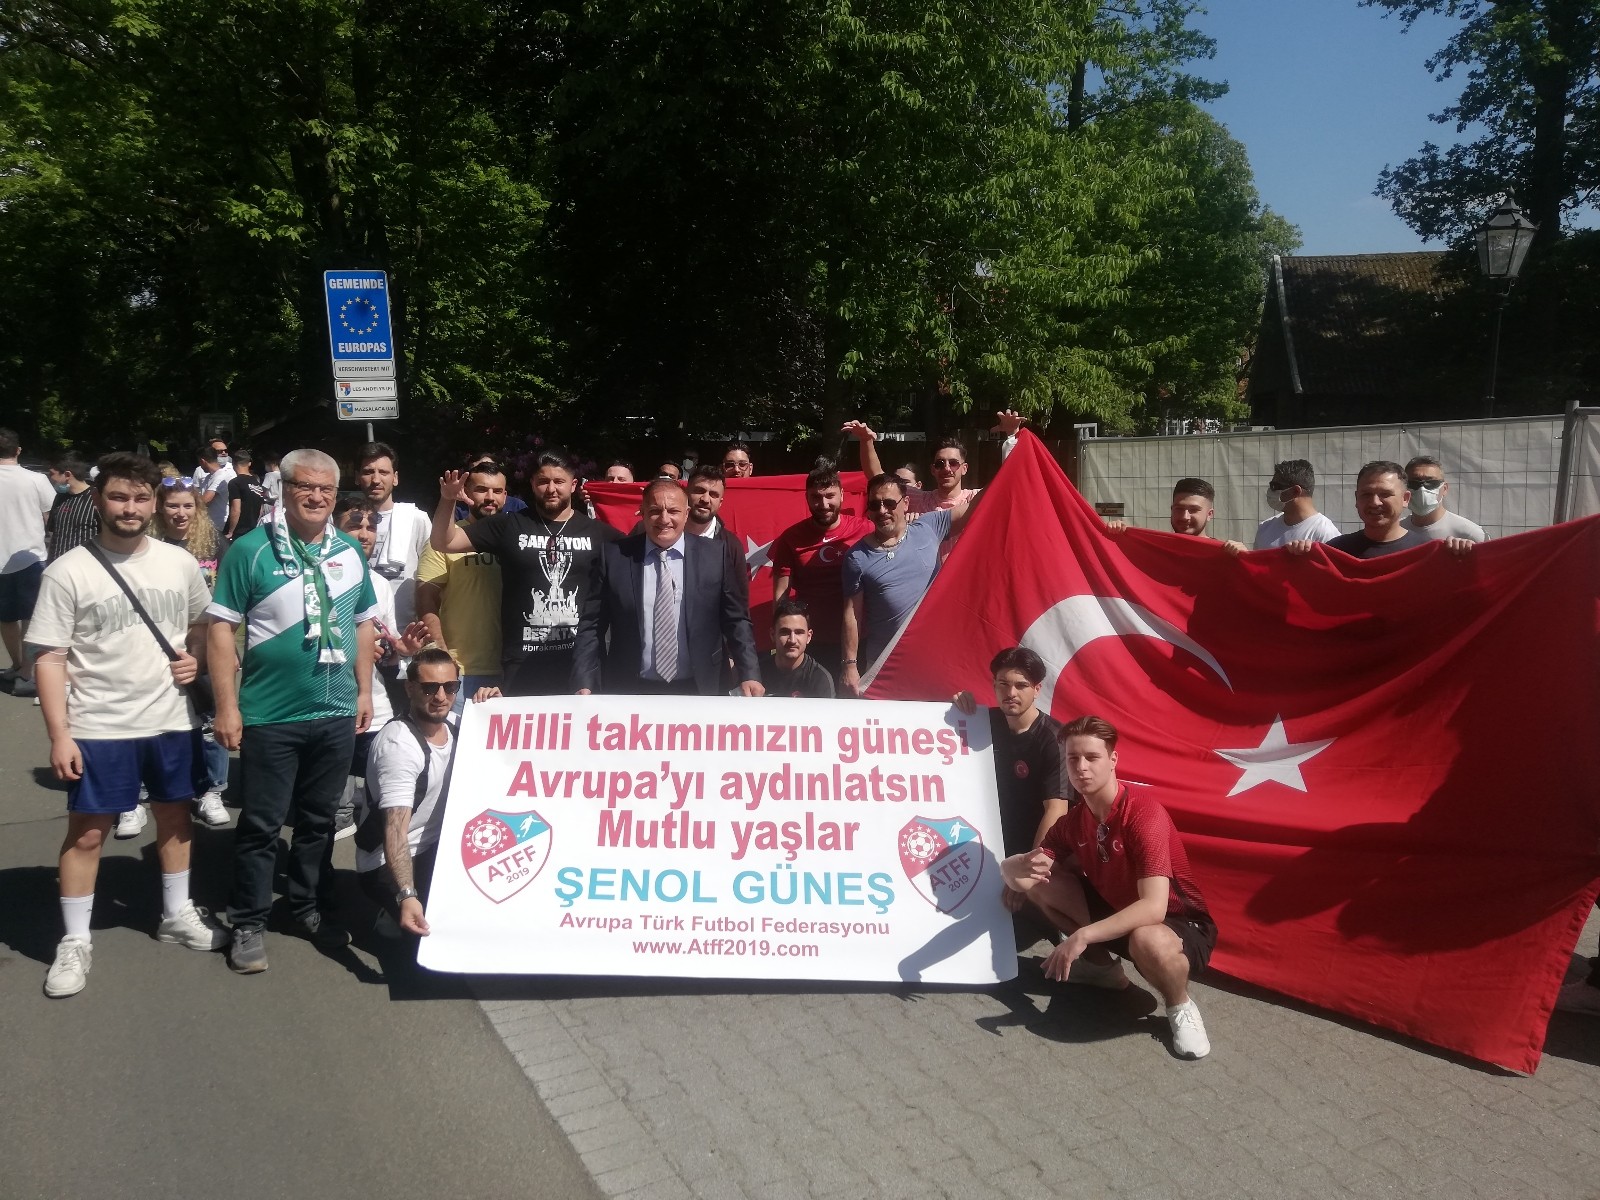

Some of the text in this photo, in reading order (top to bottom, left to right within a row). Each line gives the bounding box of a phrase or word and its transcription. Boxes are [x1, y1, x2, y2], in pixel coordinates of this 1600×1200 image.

[328, 278, 384, 290] GEMEINDE
[338, 342, 387, 353] EUROPAS
[486, 713, 971, 765] Milli takımımızın güneşi
[507, 761, 946, 810] Avrupa’yı aydınlatsın
[597, 809, 860, 861] Mutlu yaşlar
[487, 845, 536, 882] ATFF
[506, 867, 530, 883] 2019
[929, 852, 971, 891] ATFF
[554, 863, 895, 914] ŞENOL GÜNEŞ
[948, 875, 969, 892] 2019
[559, 912, 890, 937] Avrupa Türk Futbol Federasyonu
[632, 938, 819, 957] www.Atff2019.com
